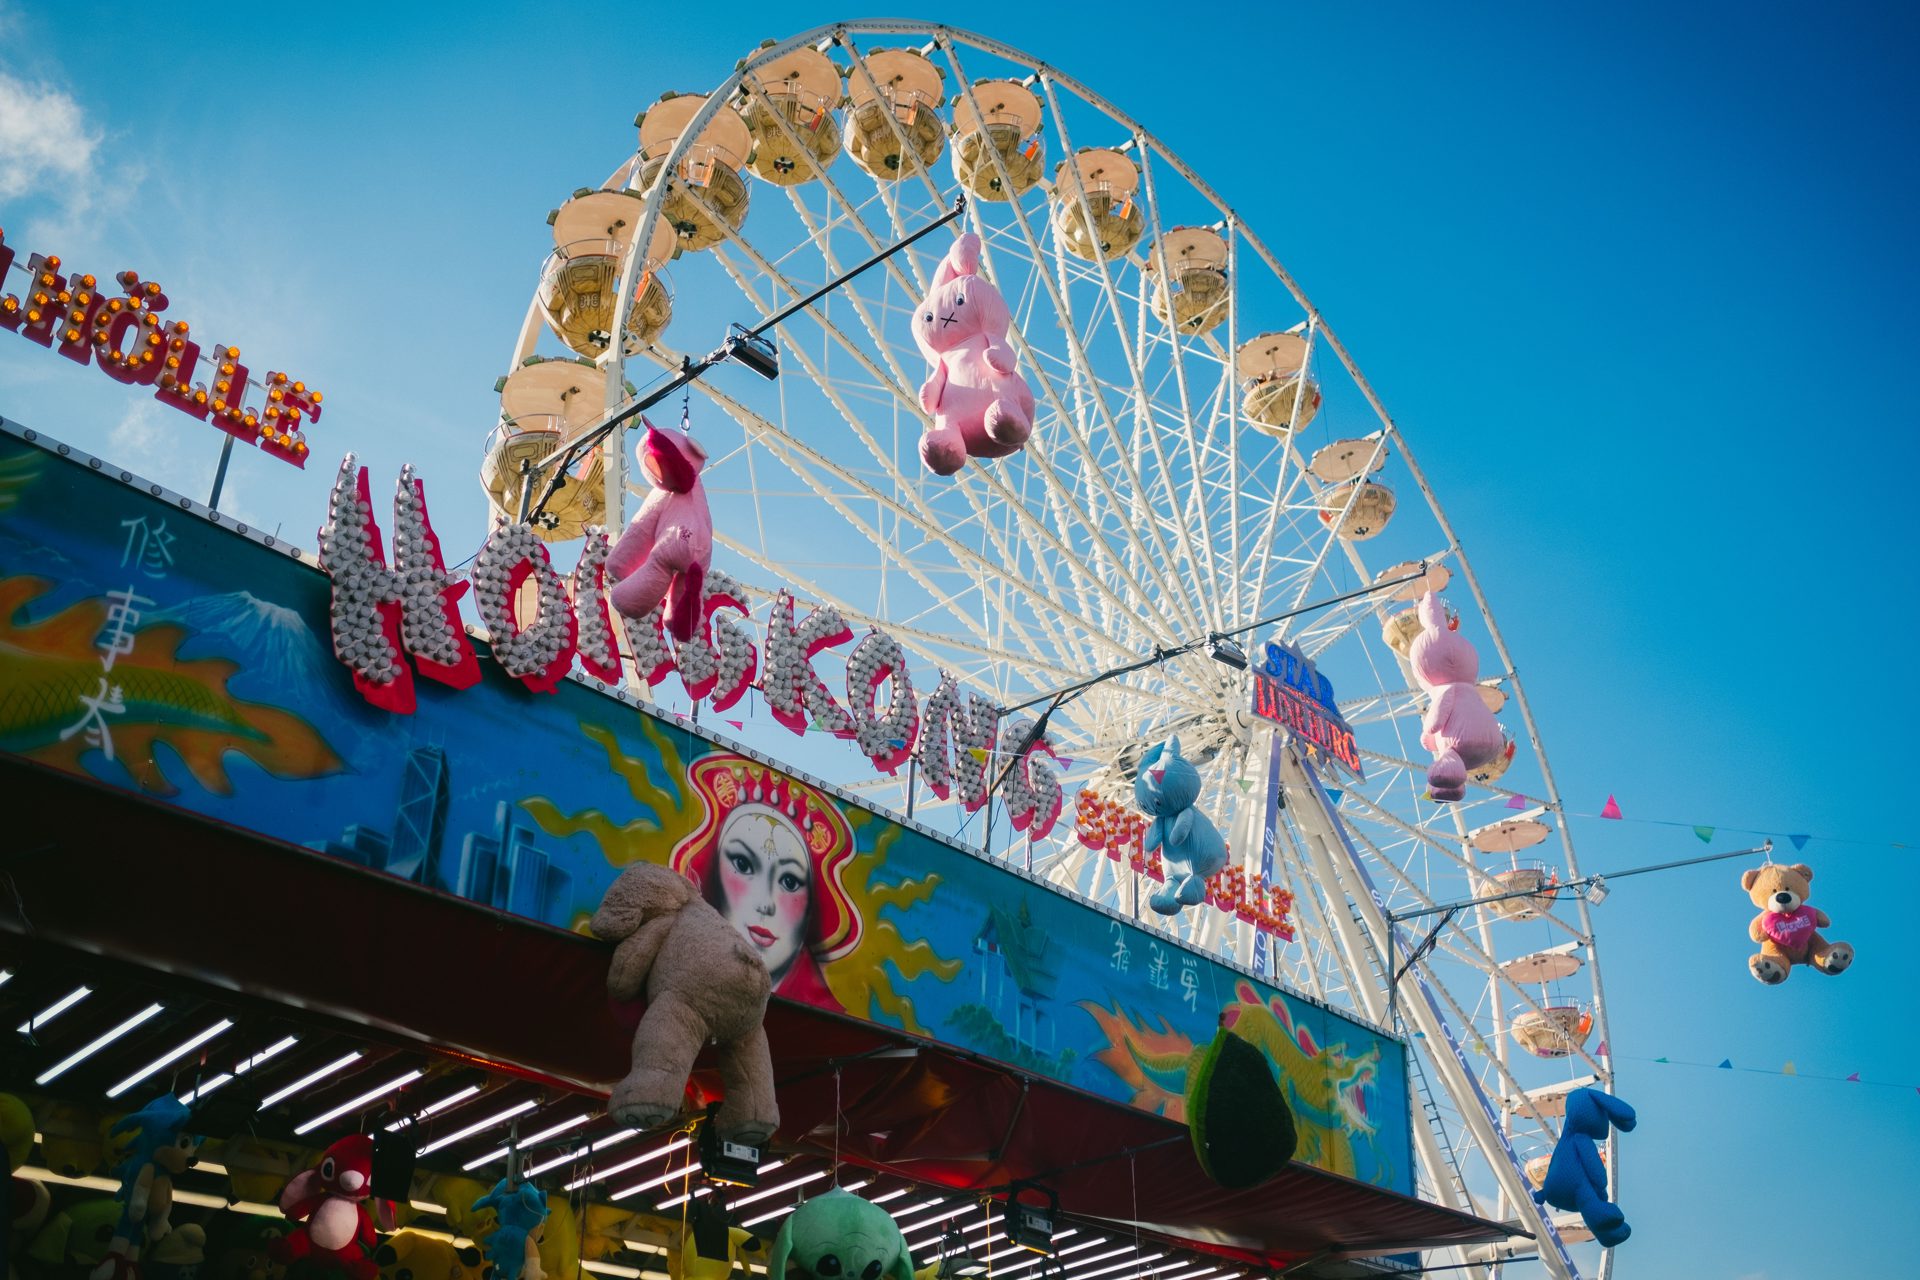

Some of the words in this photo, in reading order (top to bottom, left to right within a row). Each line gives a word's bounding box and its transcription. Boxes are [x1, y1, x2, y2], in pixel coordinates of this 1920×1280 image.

[1265, 643, 1342, 718] STAR
[1261, 826, 1275, 885] STA
[1371, 888, 1427, 988] SAR
